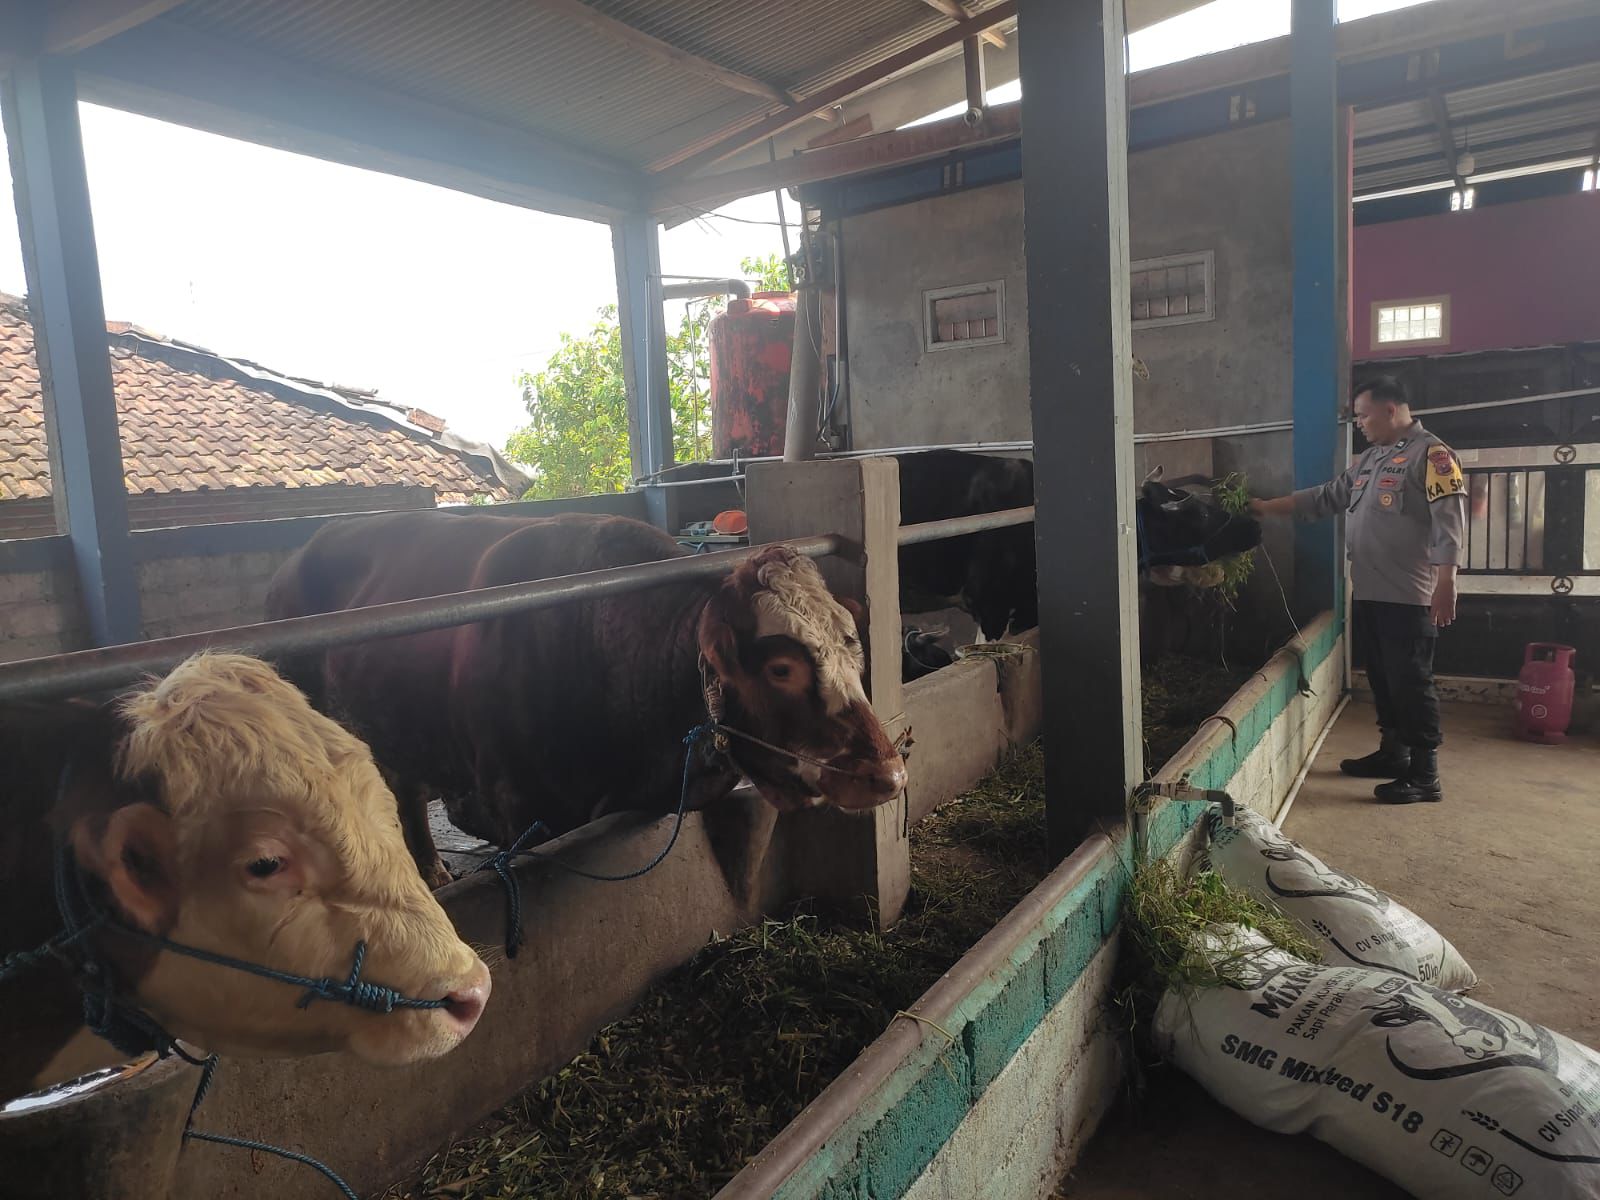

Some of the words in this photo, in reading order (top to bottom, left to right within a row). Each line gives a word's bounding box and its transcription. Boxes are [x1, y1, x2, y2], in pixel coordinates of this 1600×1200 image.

[1427, 482, 1444, 500] KA
[1355, 938, 1372, 952] CV
[1286, 999, 1319, 1036] PAKAN
[1303, 1017, 1326, 1041] Sapi
[1319, 991, 1345, 1018] Perah
[1221, 1034, 1278, 1070] SMG
[1371, 1091, 1424, 1134] S18
[1538, 1120, 1562, 1143] CV
[1555, 1100, 1587, 1128] Sinar
